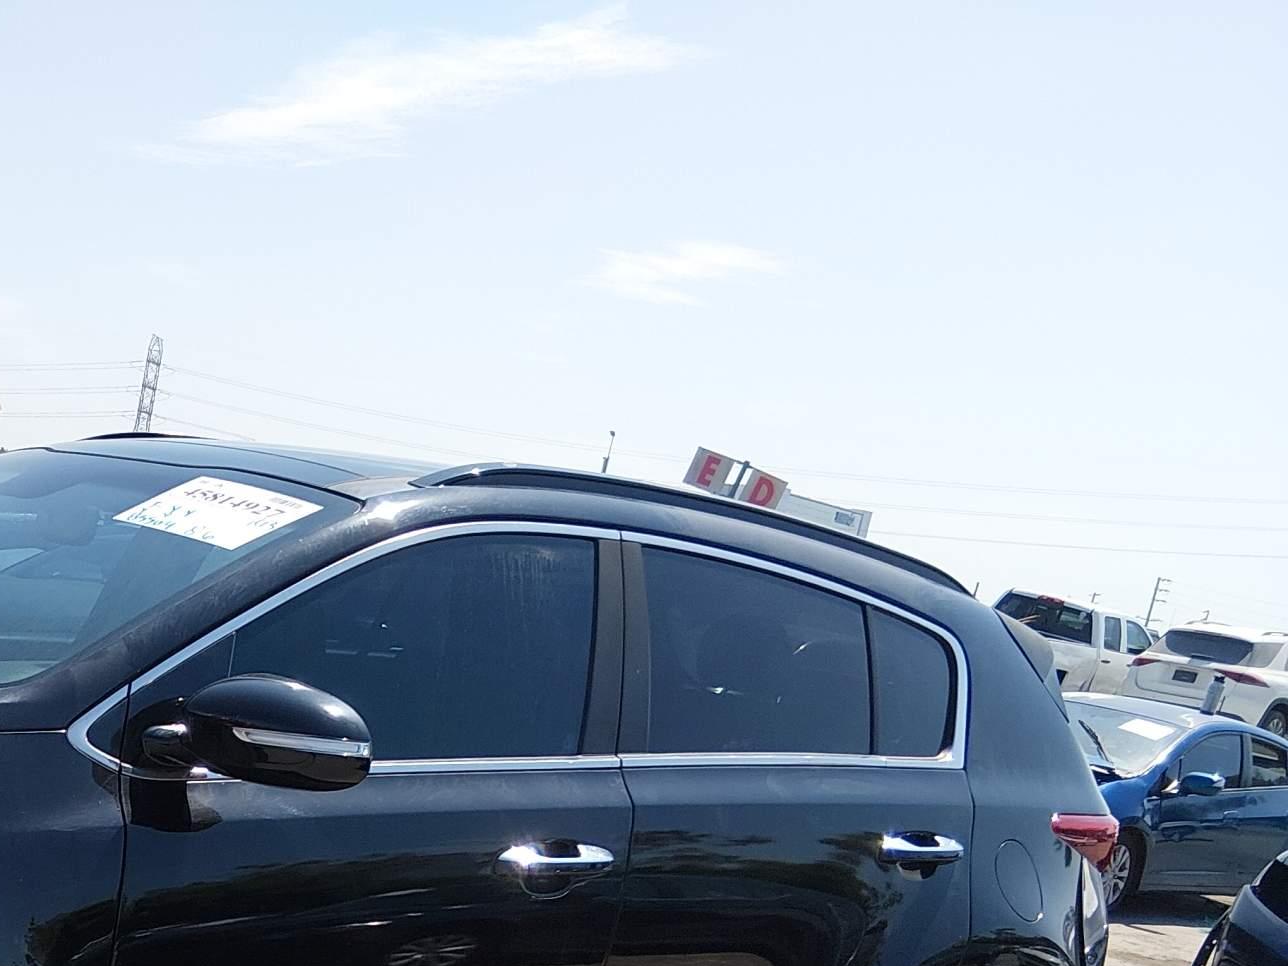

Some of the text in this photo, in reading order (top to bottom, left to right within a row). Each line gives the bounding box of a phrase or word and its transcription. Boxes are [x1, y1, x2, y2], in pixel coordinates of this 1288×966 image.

[696, 455, 774, 506] E D
[183, 488, 286, 518] 45814927
